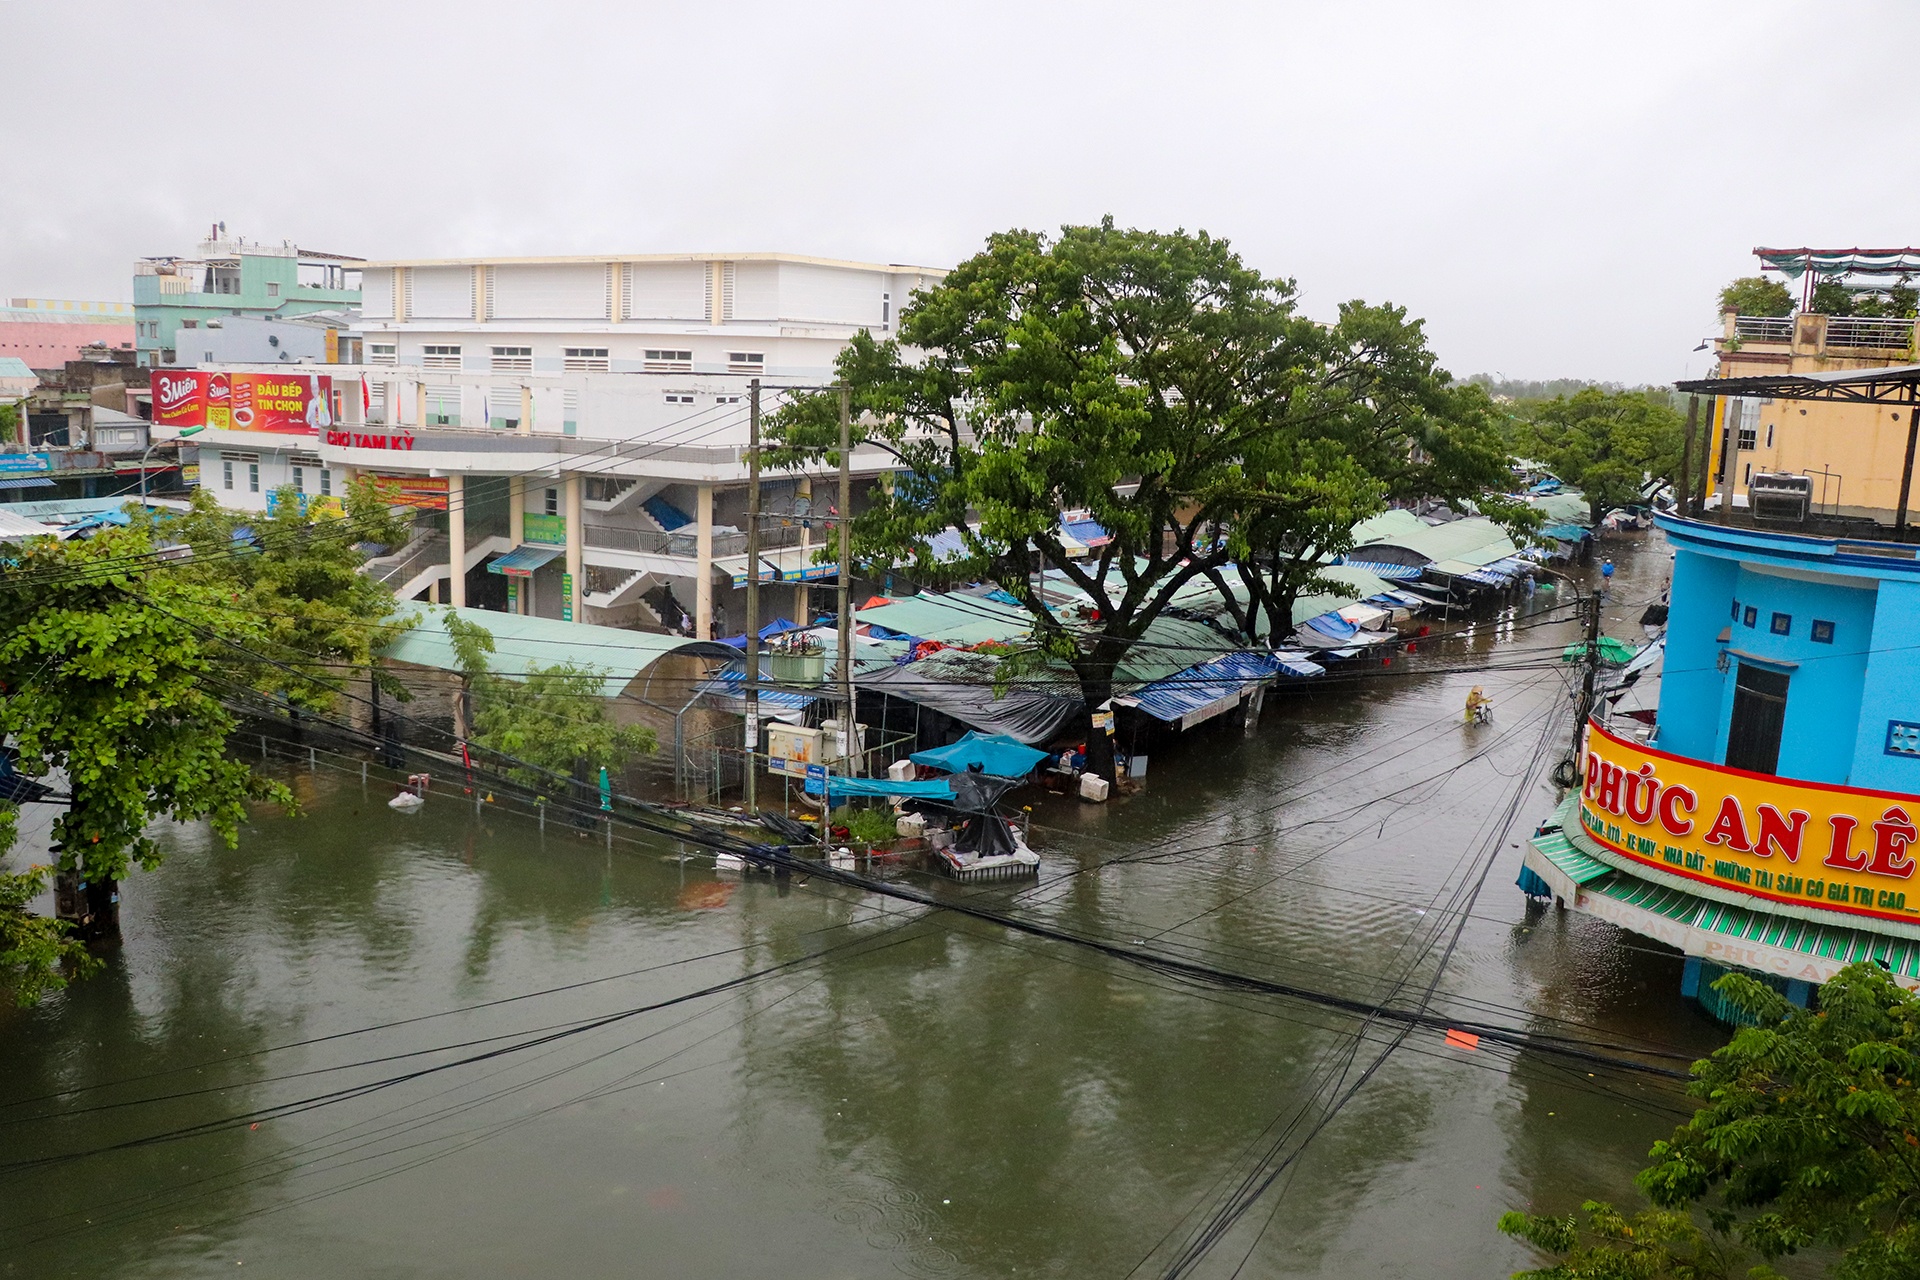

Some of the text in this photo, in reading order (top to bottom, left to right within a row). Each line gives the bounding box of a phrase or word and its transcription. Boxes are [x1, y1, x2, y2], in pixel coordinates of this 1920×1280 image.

[257, 380, 303, 397] ĐẦU BẾP
[258, 399, 303, 415] TIN CHỌN
[327, 429, 415, 451] CHỢ TAM KỲ
[1584, 751, 1919, 879] PHÚC AN LÊ
[1626, 832, 1637, 850] XE
[1637, 836, 1657, 858] MÁY
[1663, 844, 1684, 867] NHÀ
[1685, 848, 1706, 871] ĐẤT
[1713, 859, 1752, 885] NHỮNG
[1755, 867, 1774, 890] TÀI
[1776, 871, 1803, 895] SẢN
[1806, 877, 1825, 898] CÓ
[1828, 881, 1850, 903] GIÁ
[1853, 885, 1875, 908] TRỊ
